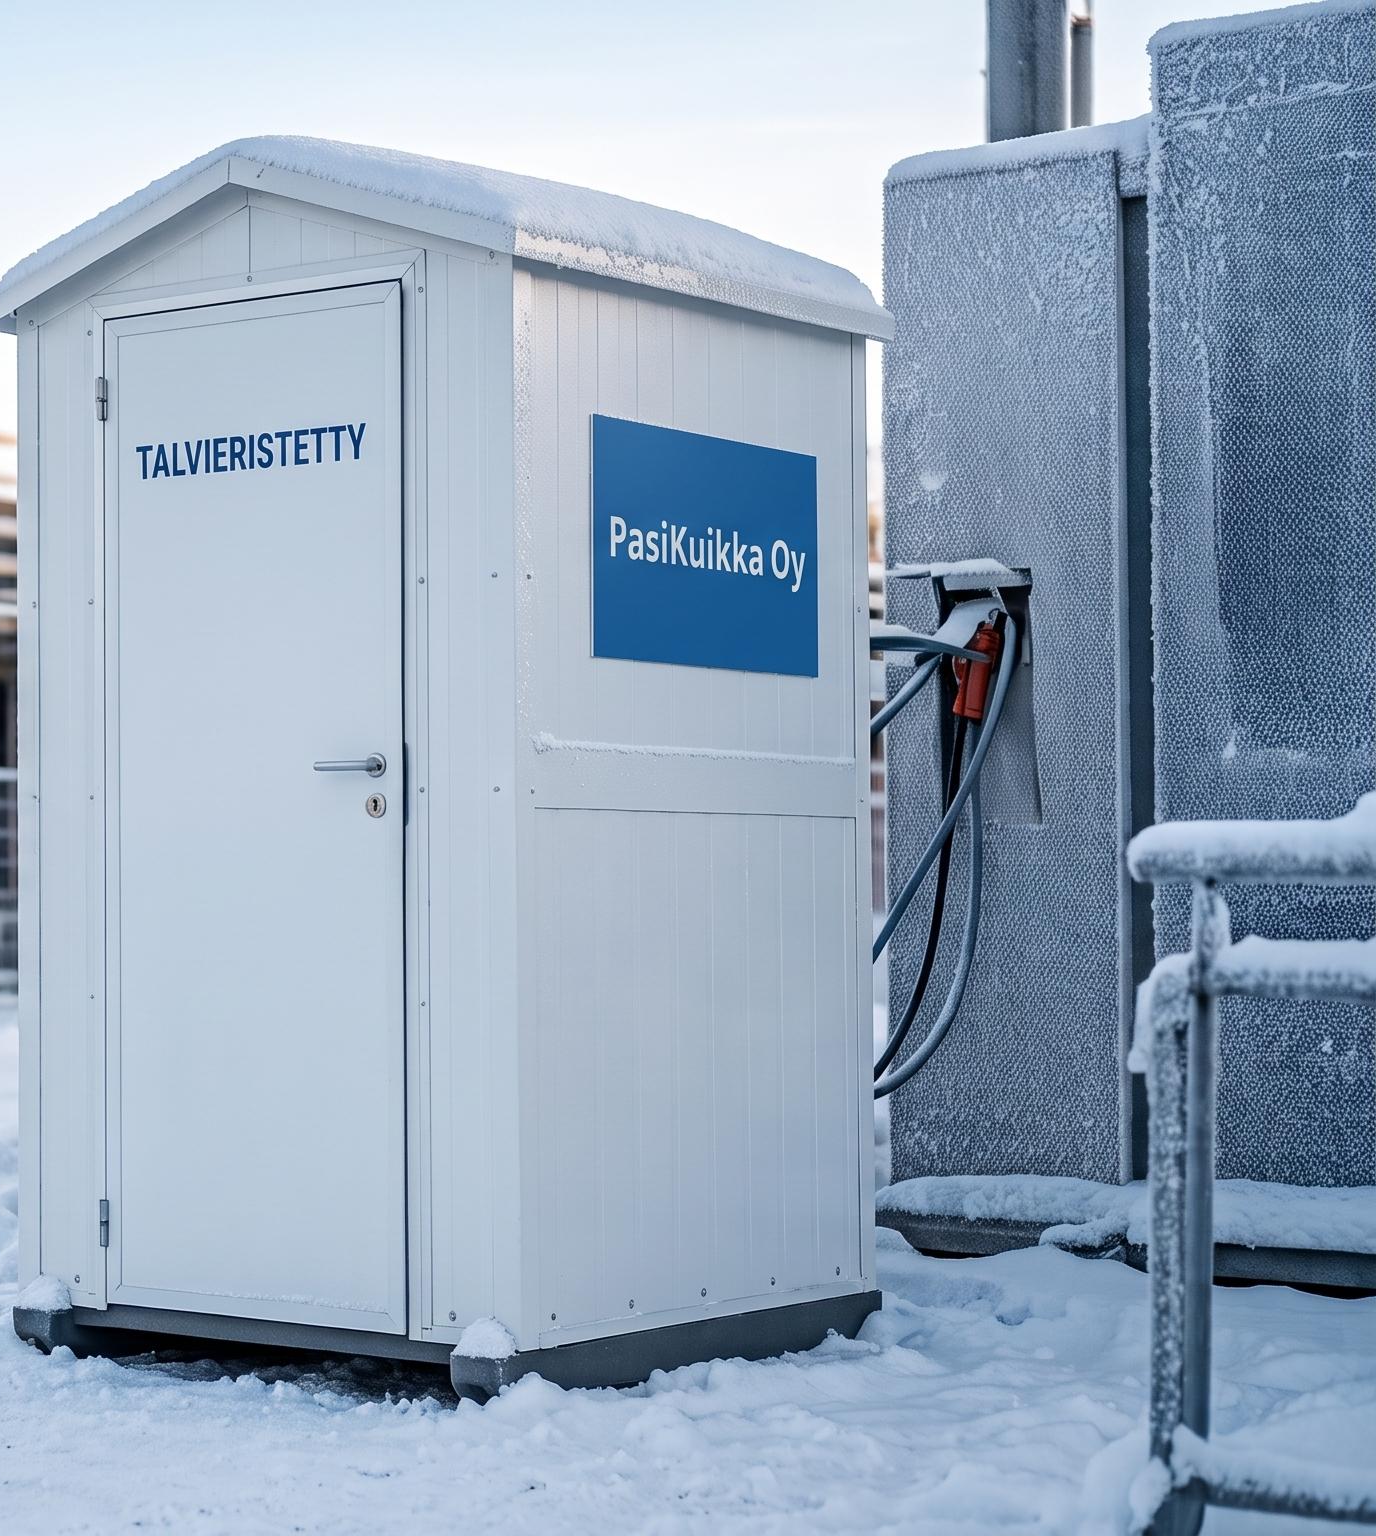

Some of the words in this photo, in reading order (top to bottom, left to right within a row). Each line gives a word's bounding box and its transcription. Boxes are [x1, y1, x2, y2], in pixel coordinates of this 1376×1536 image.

[136, 423, 366, 479] TALVIERISTETTY
[610, 516, 763, 576] PasiKuikka
[771, 540, 805, 592] Oy
